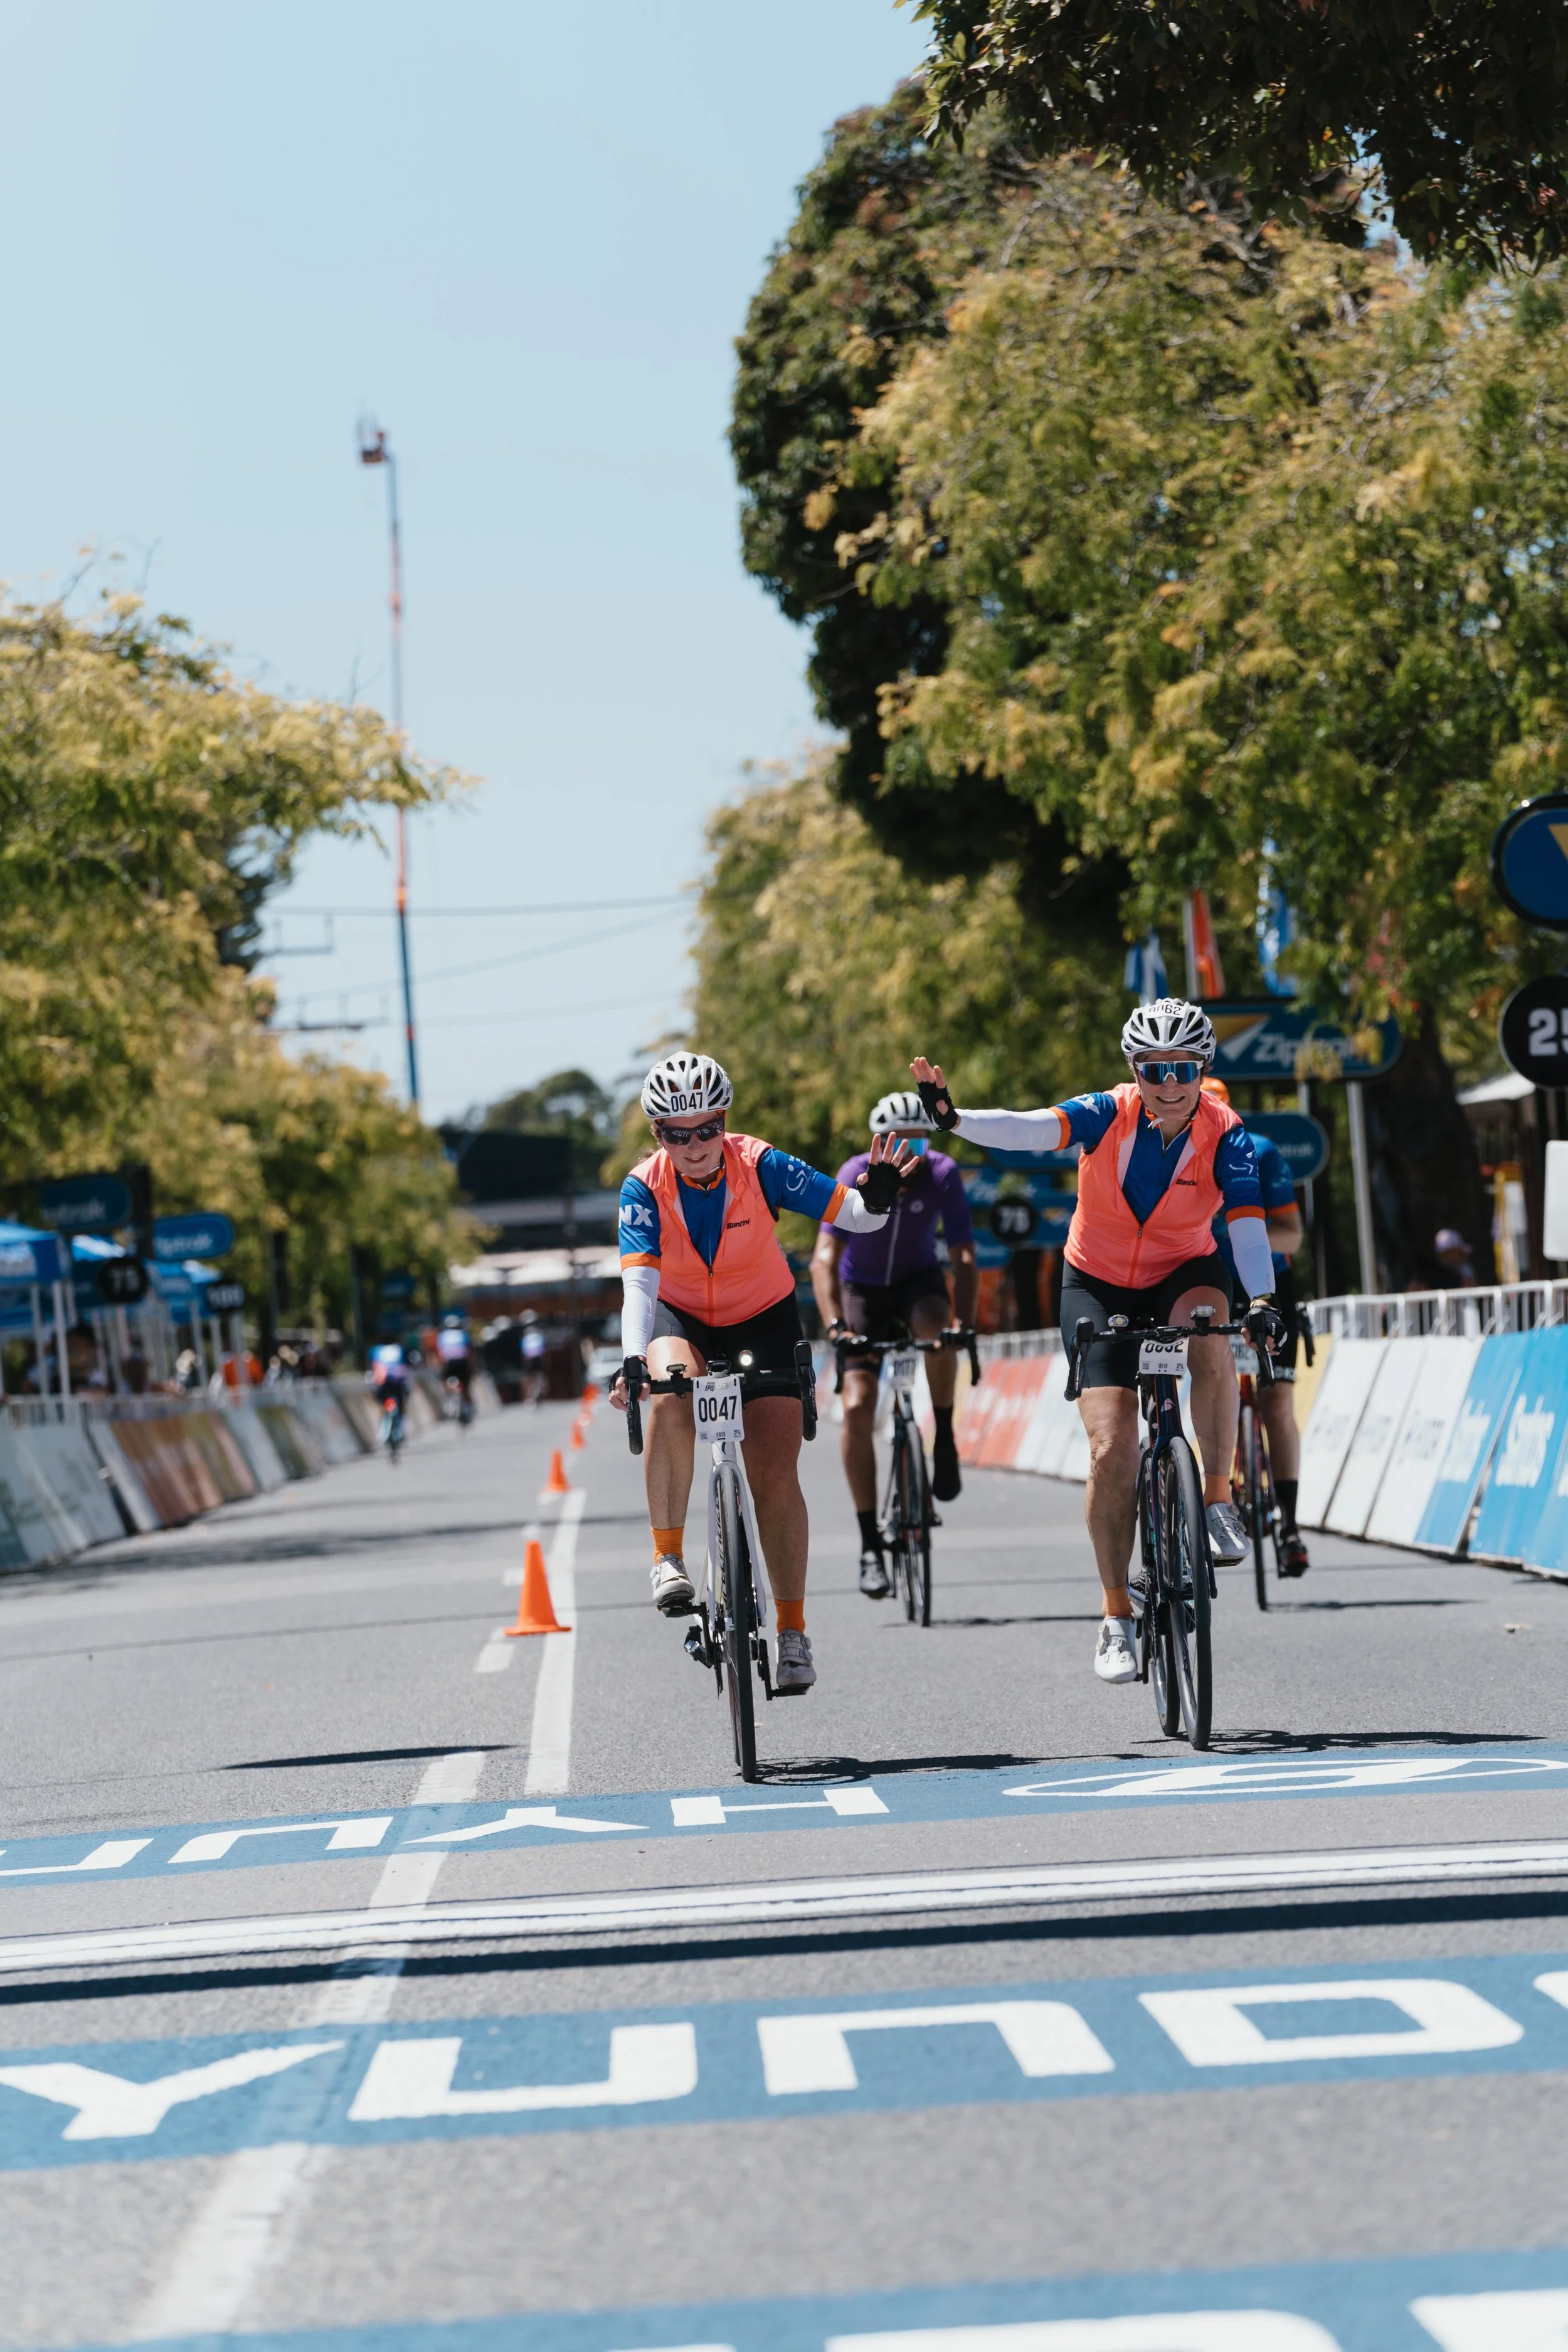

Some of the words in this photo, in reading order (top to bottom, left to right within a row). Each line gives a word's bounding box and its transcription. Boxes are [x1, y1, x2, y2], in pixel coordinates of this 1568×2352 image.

[1149, 1004, 1181, 1015] 0062
[1528, 1007, 1568, 1056] 2
[670, 1091, 703, 1112] 0047
[727, 1218, 750, 1229] Santini
[698, 1395, 738, 1423] 0047
